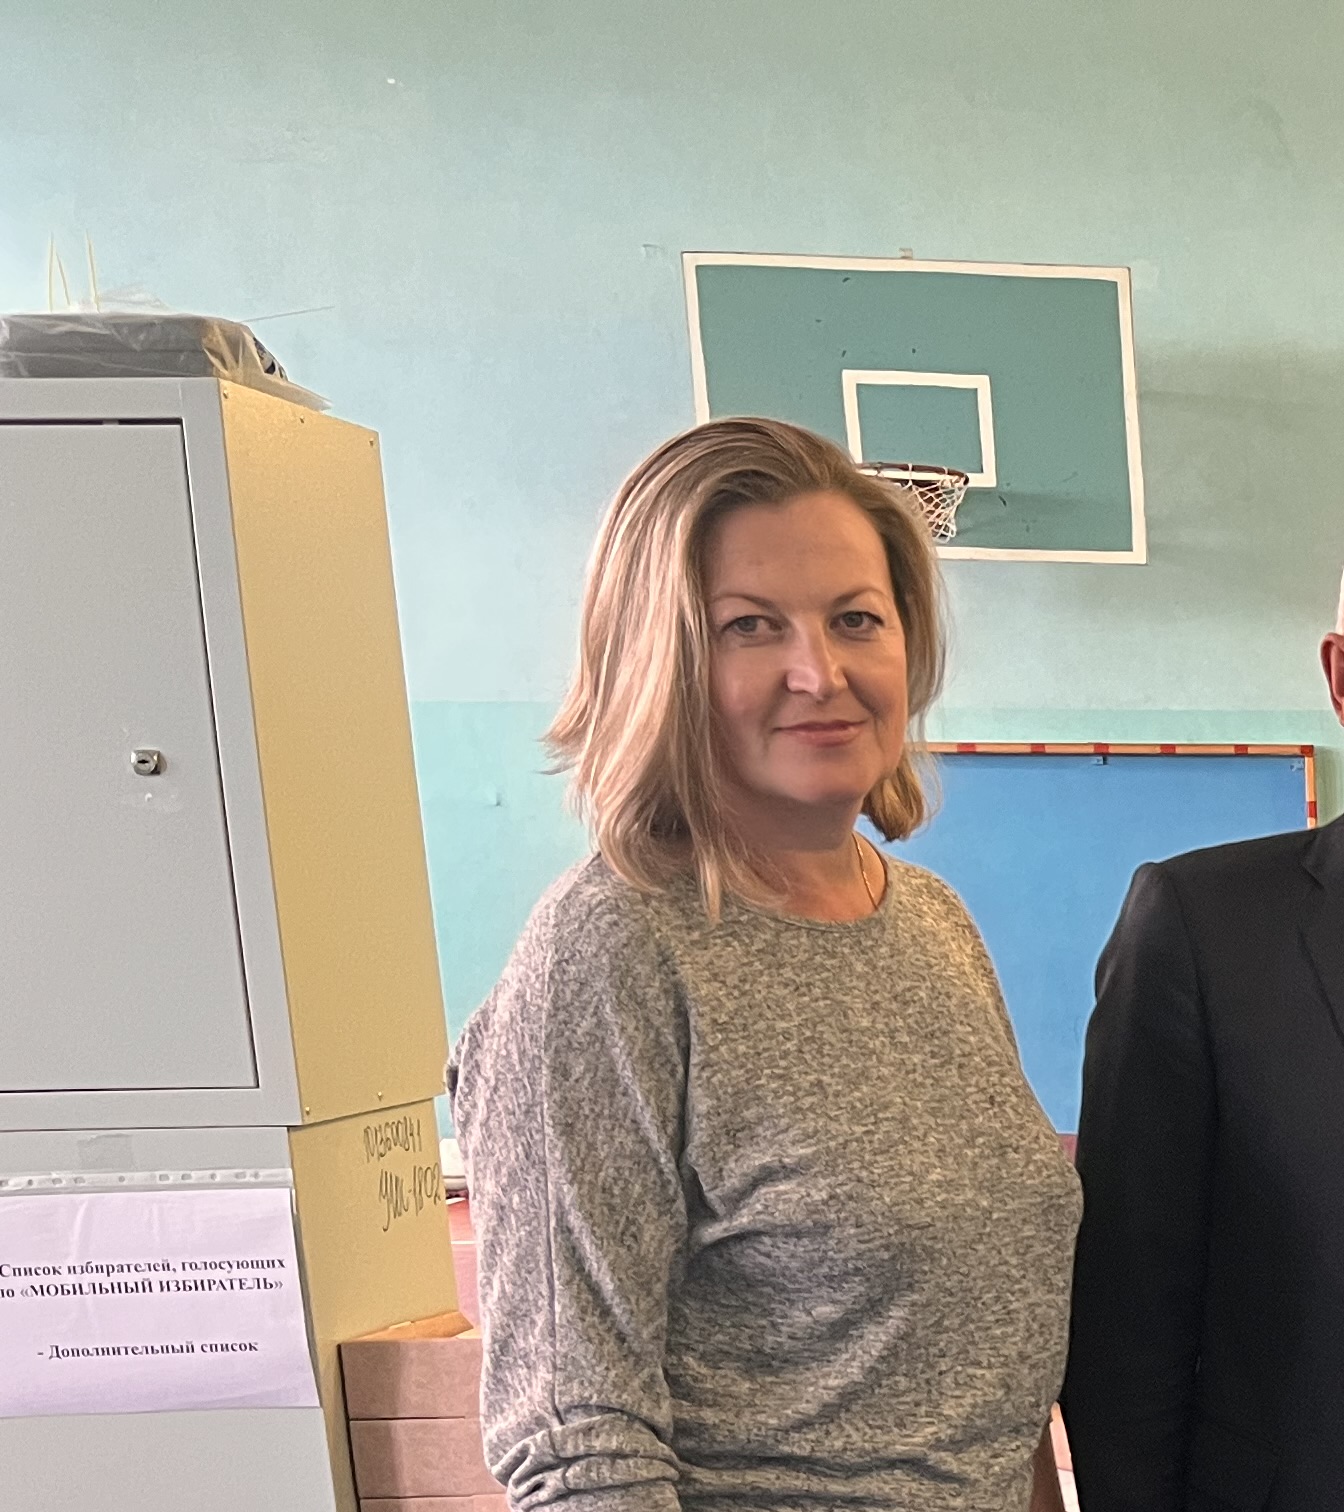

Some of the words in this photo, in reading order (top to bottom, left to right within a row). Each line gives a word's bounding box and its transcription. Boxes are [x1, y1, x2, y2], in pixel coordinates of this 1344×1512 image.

[0, 1263, 62, 1278] Список
[67, 1259, 177, 1277] избирателей,
[181, 1258, 286, 1274] голосующих
[20, 1277, 154, 1297] «МОБИЛЬНЫЙ
[159, 1277, 283, 1293] ИЗБИРАТЕЛЬ»
[48, 1340, 196, 1360] Дополнительный
[200, 1342, 259, 1354] список
